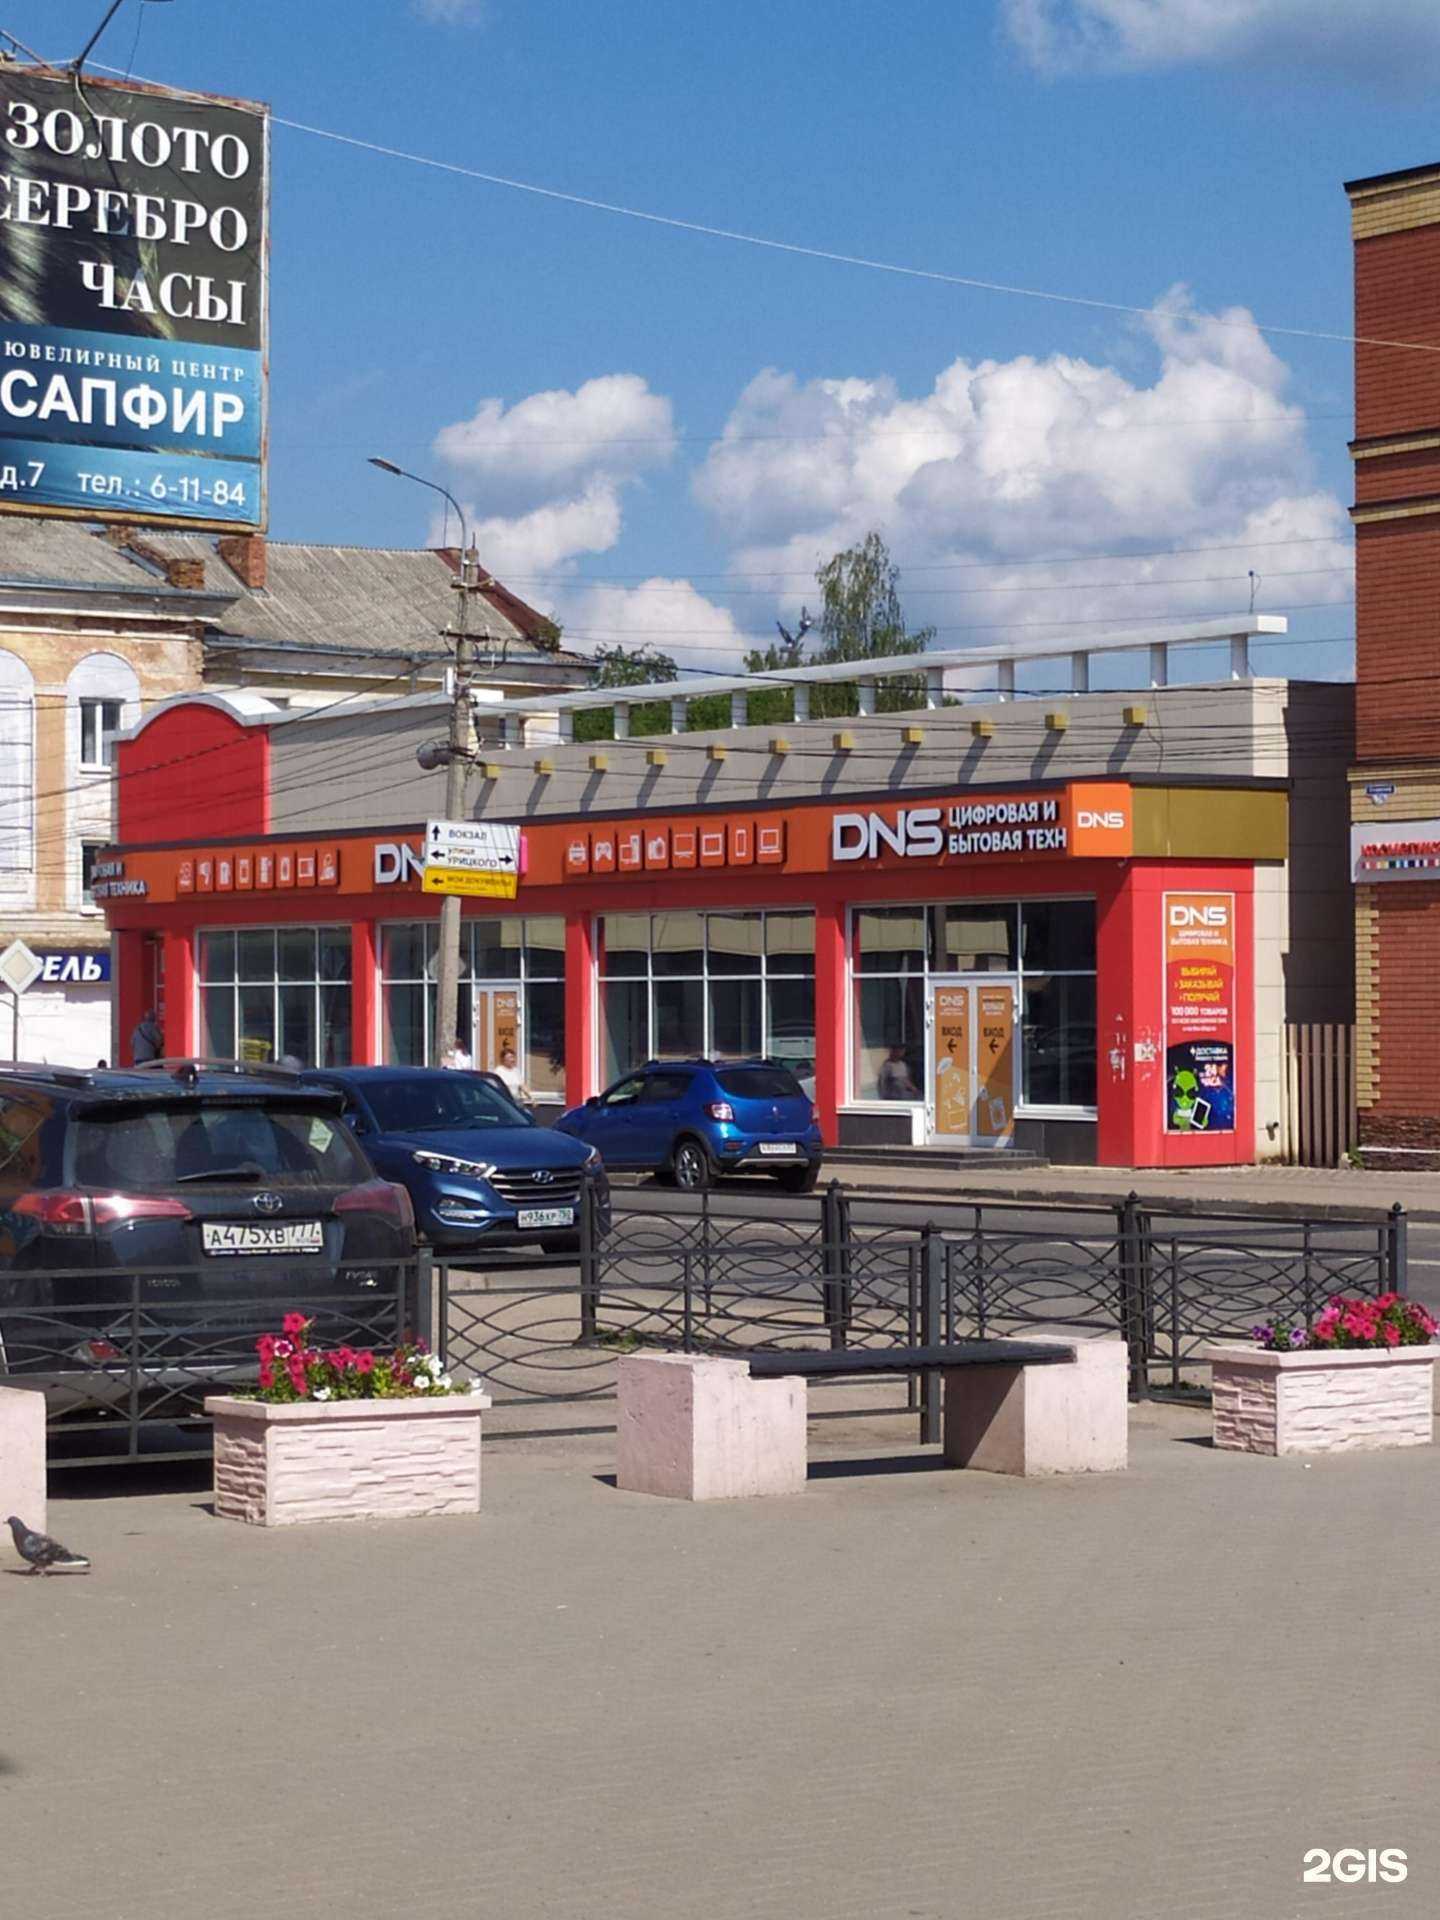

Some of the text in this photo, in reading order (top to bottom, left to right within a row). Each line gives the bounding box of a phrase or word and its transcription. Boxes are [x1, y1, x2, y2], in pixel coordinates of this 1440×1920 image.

[6, 101, 249, 179] ЗОЛОТО
[79, 260, 246, 325] ЧАСЫ
[4, 341, 245, 383] ЮВЕЛИРНЫЙ ЦЕНТР
[0, 369, 244, 438] САПФИР
[78, 472, 141, 497] тел.:
[150, 474, 246, 506] 6-11-84
[949, 800, 1056, 829] ЦИФРОВАЯ И
[1077, 811, 1125, 829] DNS
[833, 808, 943, 860] DNS
[949, 827, 1067, 854] БЫТОВАЯ ТЕХН
[374, 842, 426, 884] DN
[1169, 905, 1228, 927] DNS
[35, 955, 102, 981] ЕЛЬ
